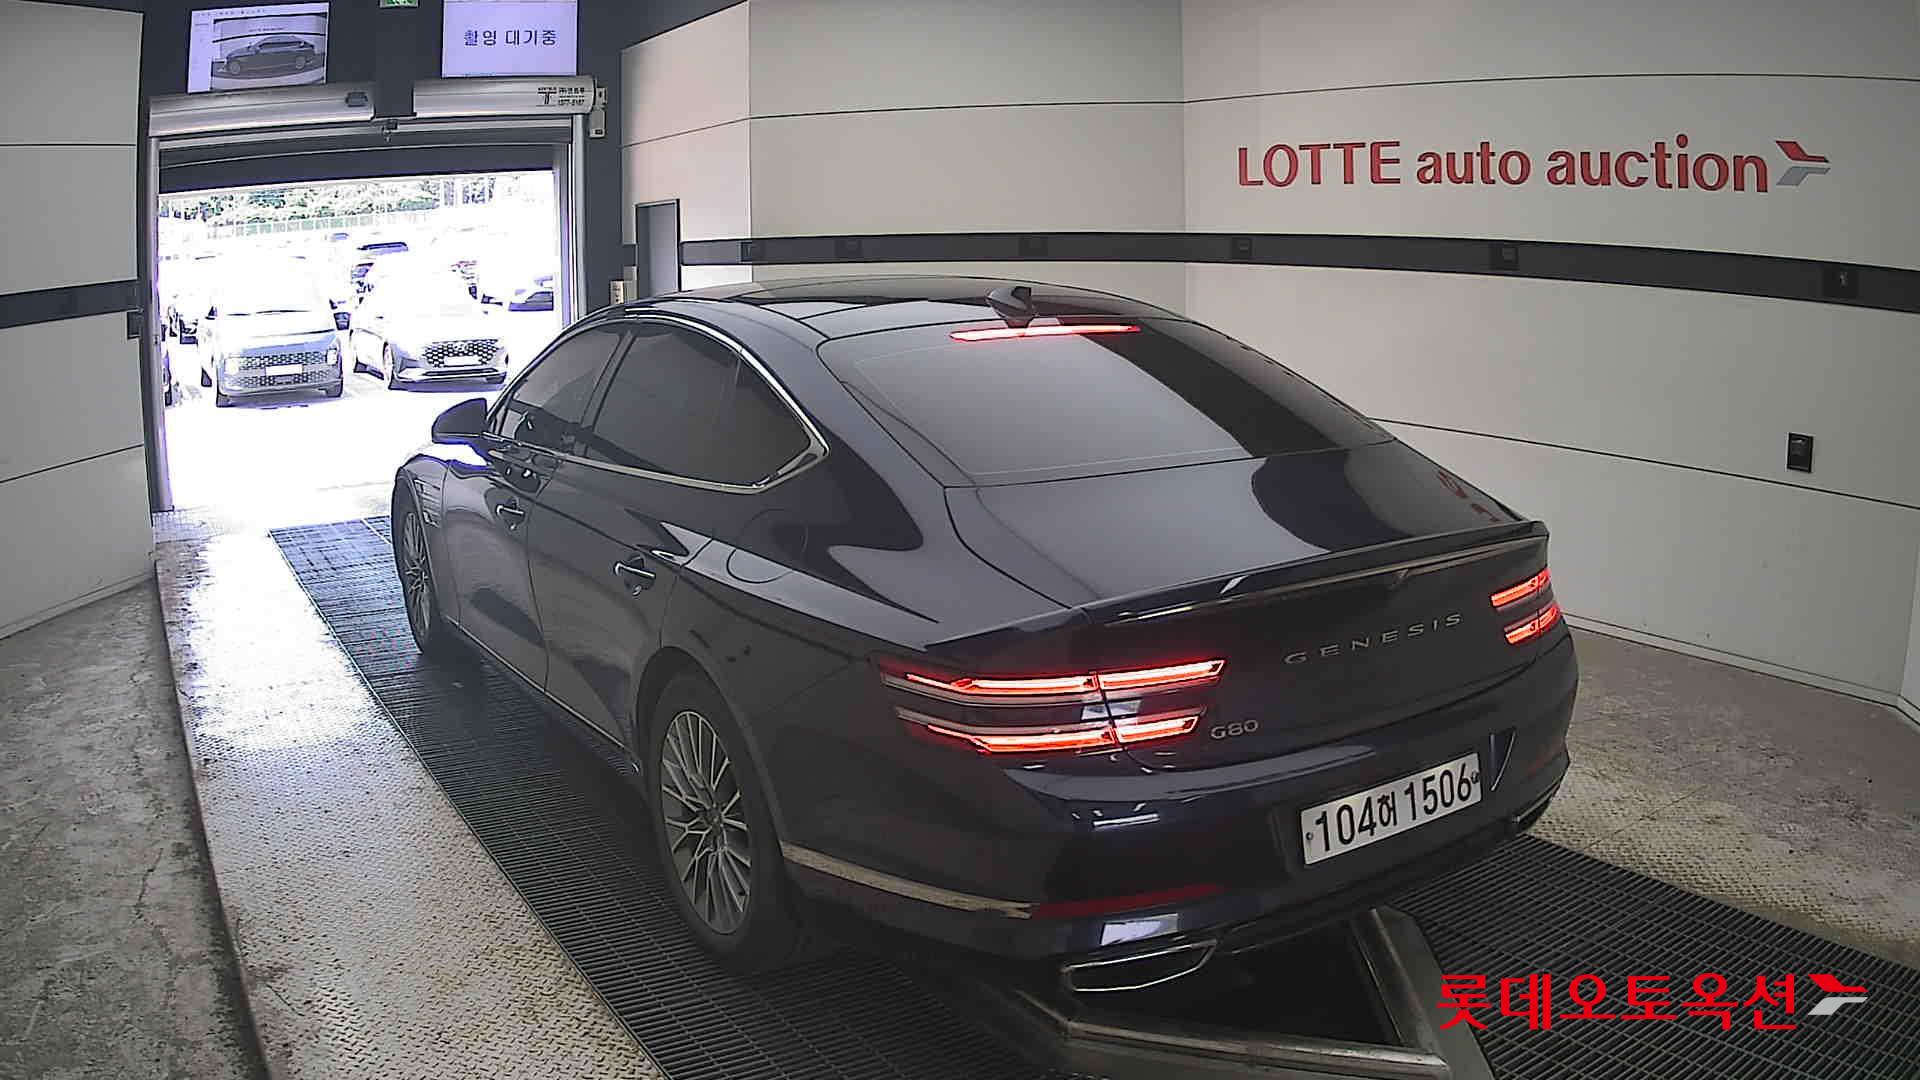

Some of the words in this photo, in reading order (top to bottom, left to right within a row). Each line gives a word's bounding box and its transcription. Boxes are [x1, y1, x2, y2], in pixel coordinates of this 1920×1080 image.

[505, 29, 557, 46] 대기중
[1238, 141, 1401, 188] LOTTE
[1416, 141, 1531, 185] auto
[1546, 133, 1769, 193] auction
[1284, 612, 1463, 665] GENESIS
[1210, 718, 1260, 740] G80
[1404, 762, 1473, 821] 1506
